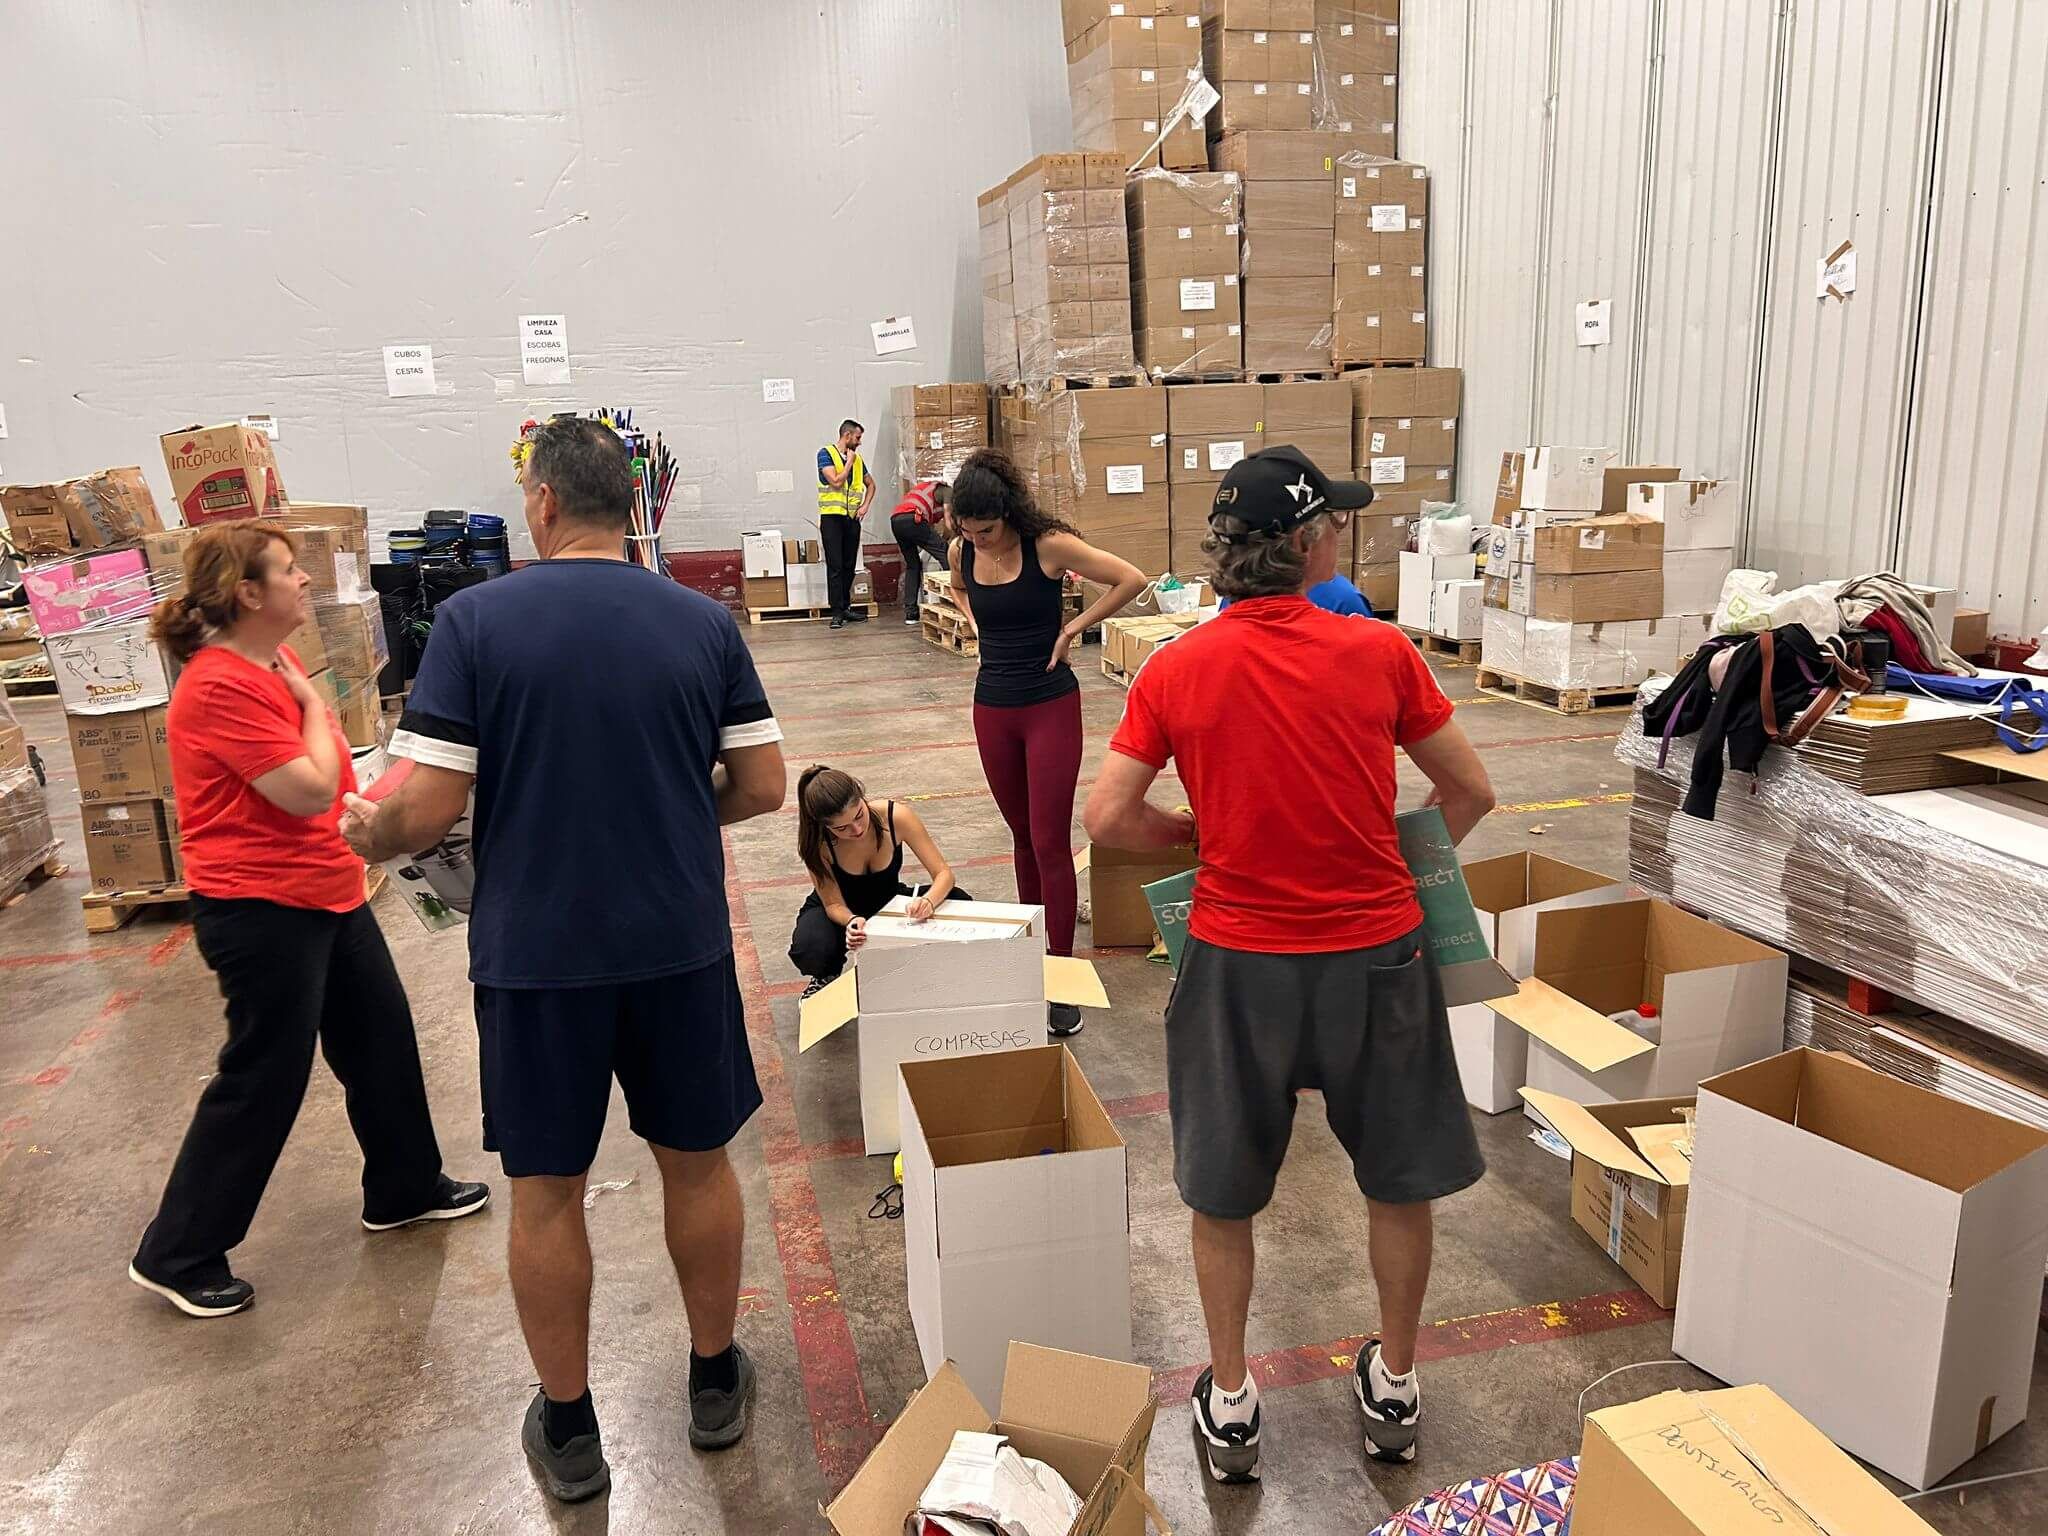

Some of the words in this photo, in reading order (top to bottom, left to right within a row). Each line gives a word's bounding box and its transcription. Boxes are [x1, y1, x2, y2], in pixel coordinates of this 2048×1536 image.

[527, 319, 558, 327] LIMPIEZA
[1584, 320, 1599, 328] ROPA
[527, 341, 561, 349] ESCOBAS
[394, 350, 422, 358] CUBOS
[526, 355, 566, 364] FREGONAS
[395, 367, 424, 375] CESTAS
[172, 445, 239, 470] IncoPack
[1414, 869, 1456, 889] RECT
[1162, 906, 1190, 925] SO
[914, 1029, 1031, 1054] COMPRESAS
[1223, 1388, 1248, 1406] PUMA
